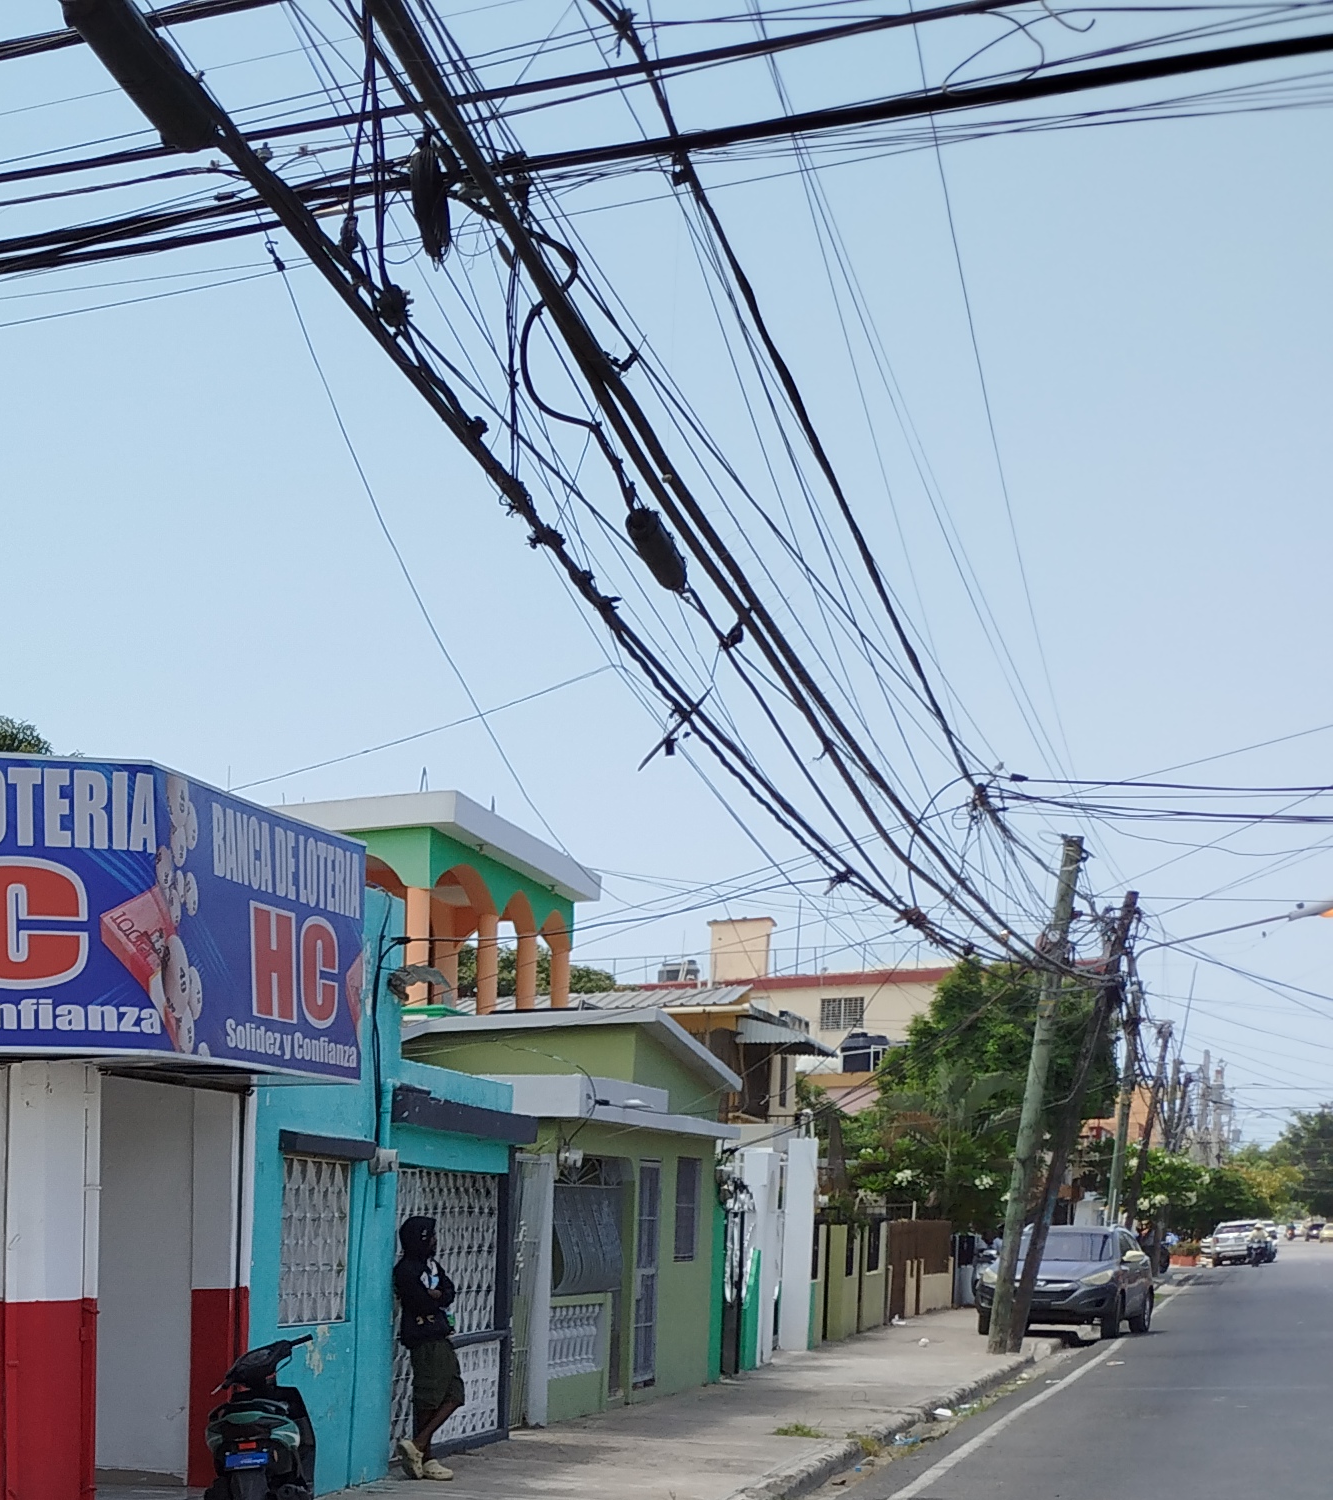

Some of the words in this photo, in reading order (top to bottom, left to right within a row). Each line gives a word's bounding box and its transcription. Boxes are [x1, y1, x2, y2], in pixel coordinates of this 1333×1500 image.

[212, 802, 273, 894] BANCA
[275, 826, 296, 900] DE
[298, 834, 361, 920] LOTERIA
[249, 900, 339, 1030] HC
[226, 1018, 282, 1056] Solidez
[283, 1033, 292, 1060] y
[294, 1031, 357, 1068] Confianza
